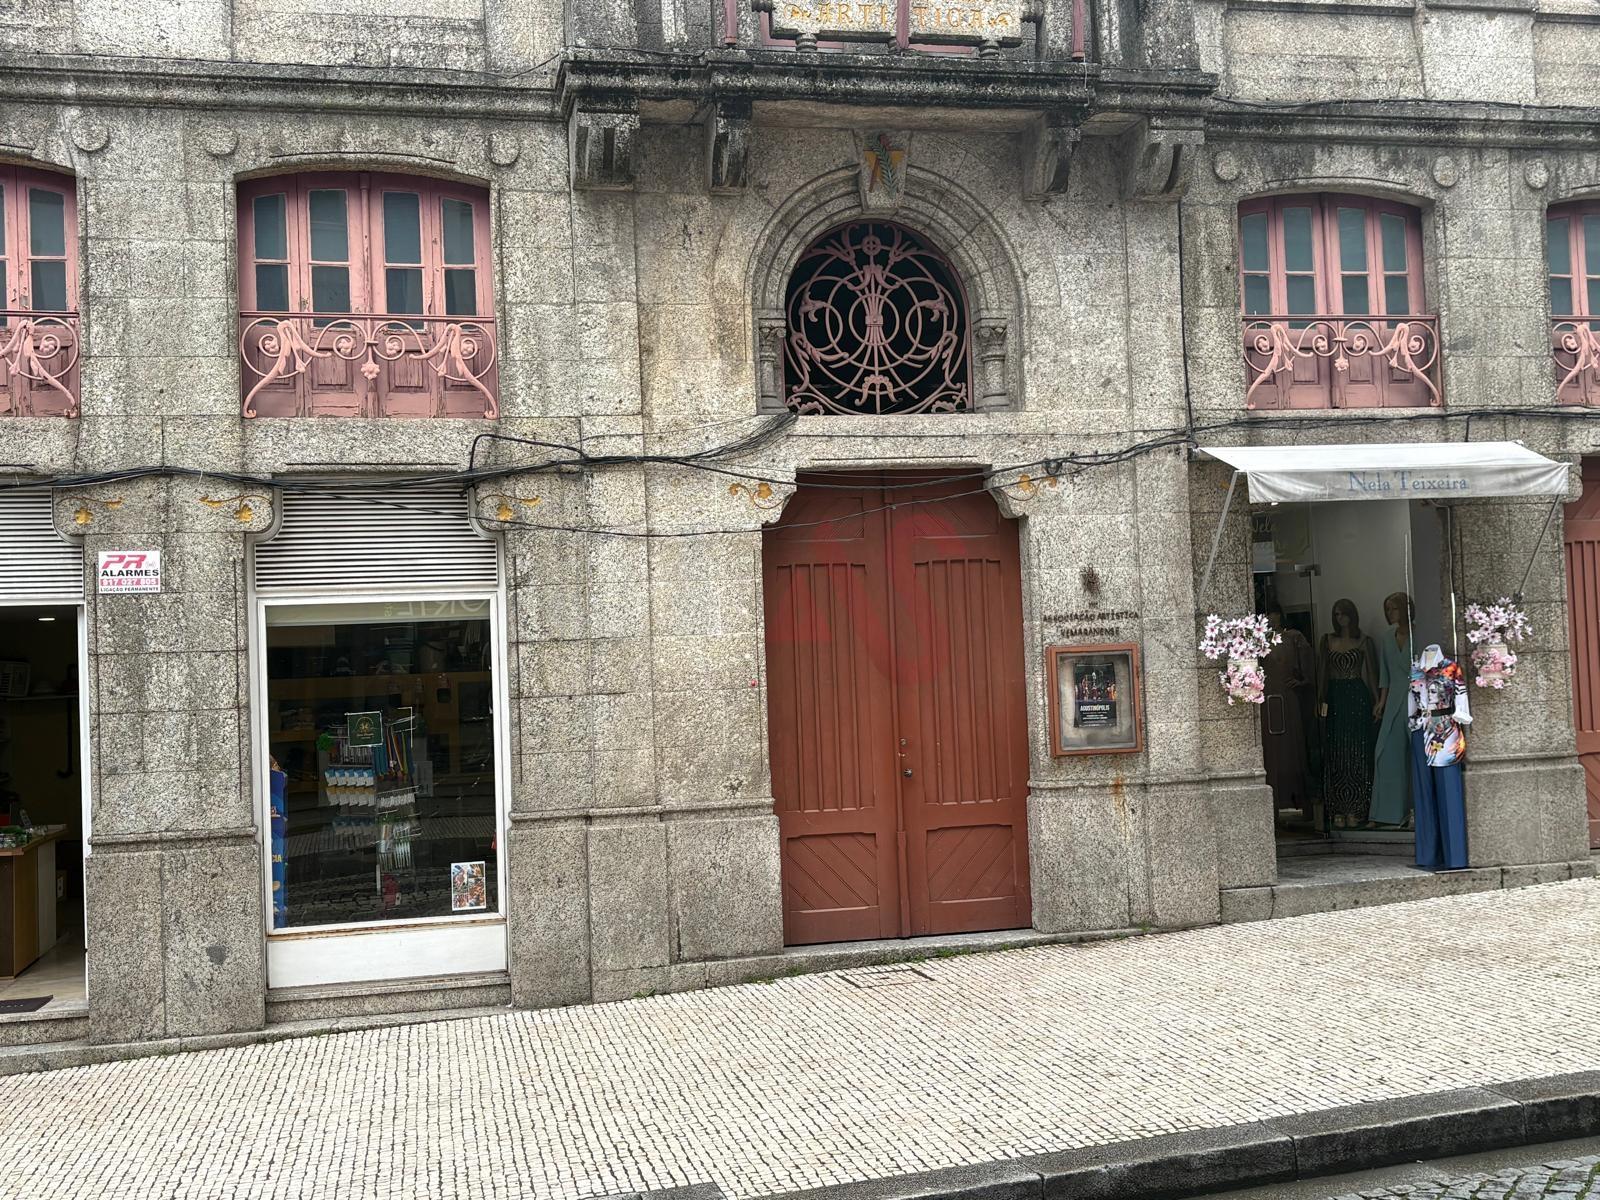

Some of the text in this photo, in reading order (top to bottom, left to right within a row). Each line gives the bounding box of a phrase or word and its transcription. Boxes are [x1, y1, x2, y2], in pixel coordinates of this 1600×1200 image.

[816, 3, 984, 28] ARTITICA
[1348, 470, 1468, 492] Nela Teixeira
[101, 554, 147, 569] PR
[101, 569, 159, 577] ALARMES
[102, 578, 118, 586] 917
